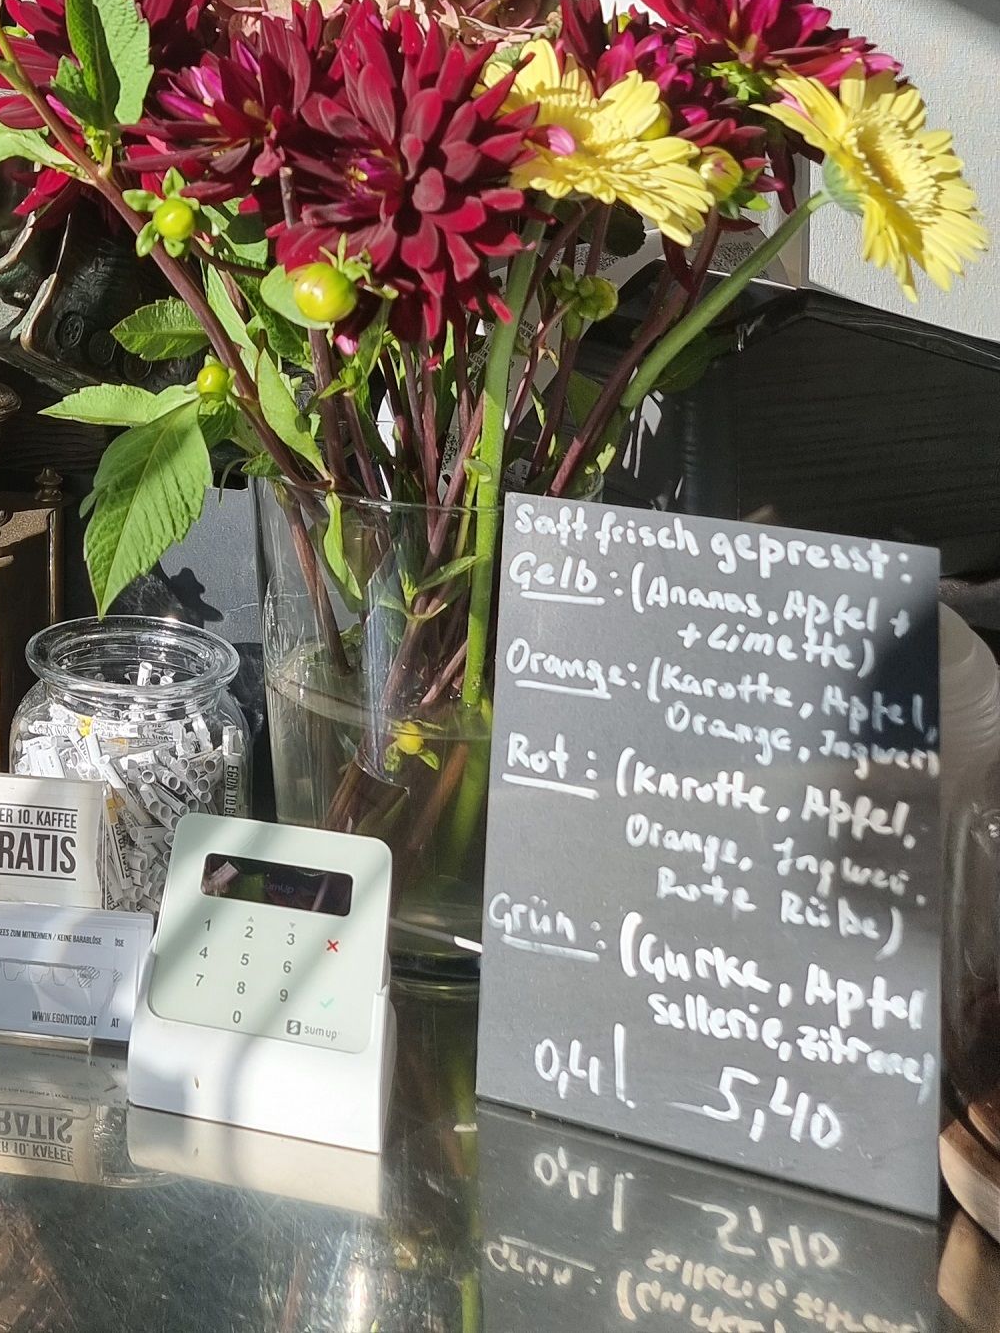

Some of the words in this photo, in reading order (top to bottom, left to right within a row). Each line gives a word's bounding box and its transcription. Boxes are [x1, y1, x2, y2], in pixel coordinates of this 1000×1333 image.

[515, 503, 588, 546] Saft
[594, 511, 699, 556] frisch
[783, 590, 879, 637] Apfel
[226, 764, 239, 792] EGON
[17, 809, 33, 825] 10.
[36, 810, 77, 829] KAFFEE
[657, 866, 758, 912] Rote
[10, 929, 21, 938] ZUM
[22, 930, 52, 941] MITNEHMEN
[57, 933, 72, 943] KEINE
[204, 919, 212, 932] 1
[244, 926, 254, 938] 2
[286, 933, 295, 946] 3
[199, 947, 209, 959] 4
[240, 953, 250, 966] 5
[283, 960, 292, 974] 6
[195, 974, 204, 987] 7
[236, 981, 246, 995] 8
[279, 989, 289, 1003] 9
[232, 1010, 242, 1024] 0
